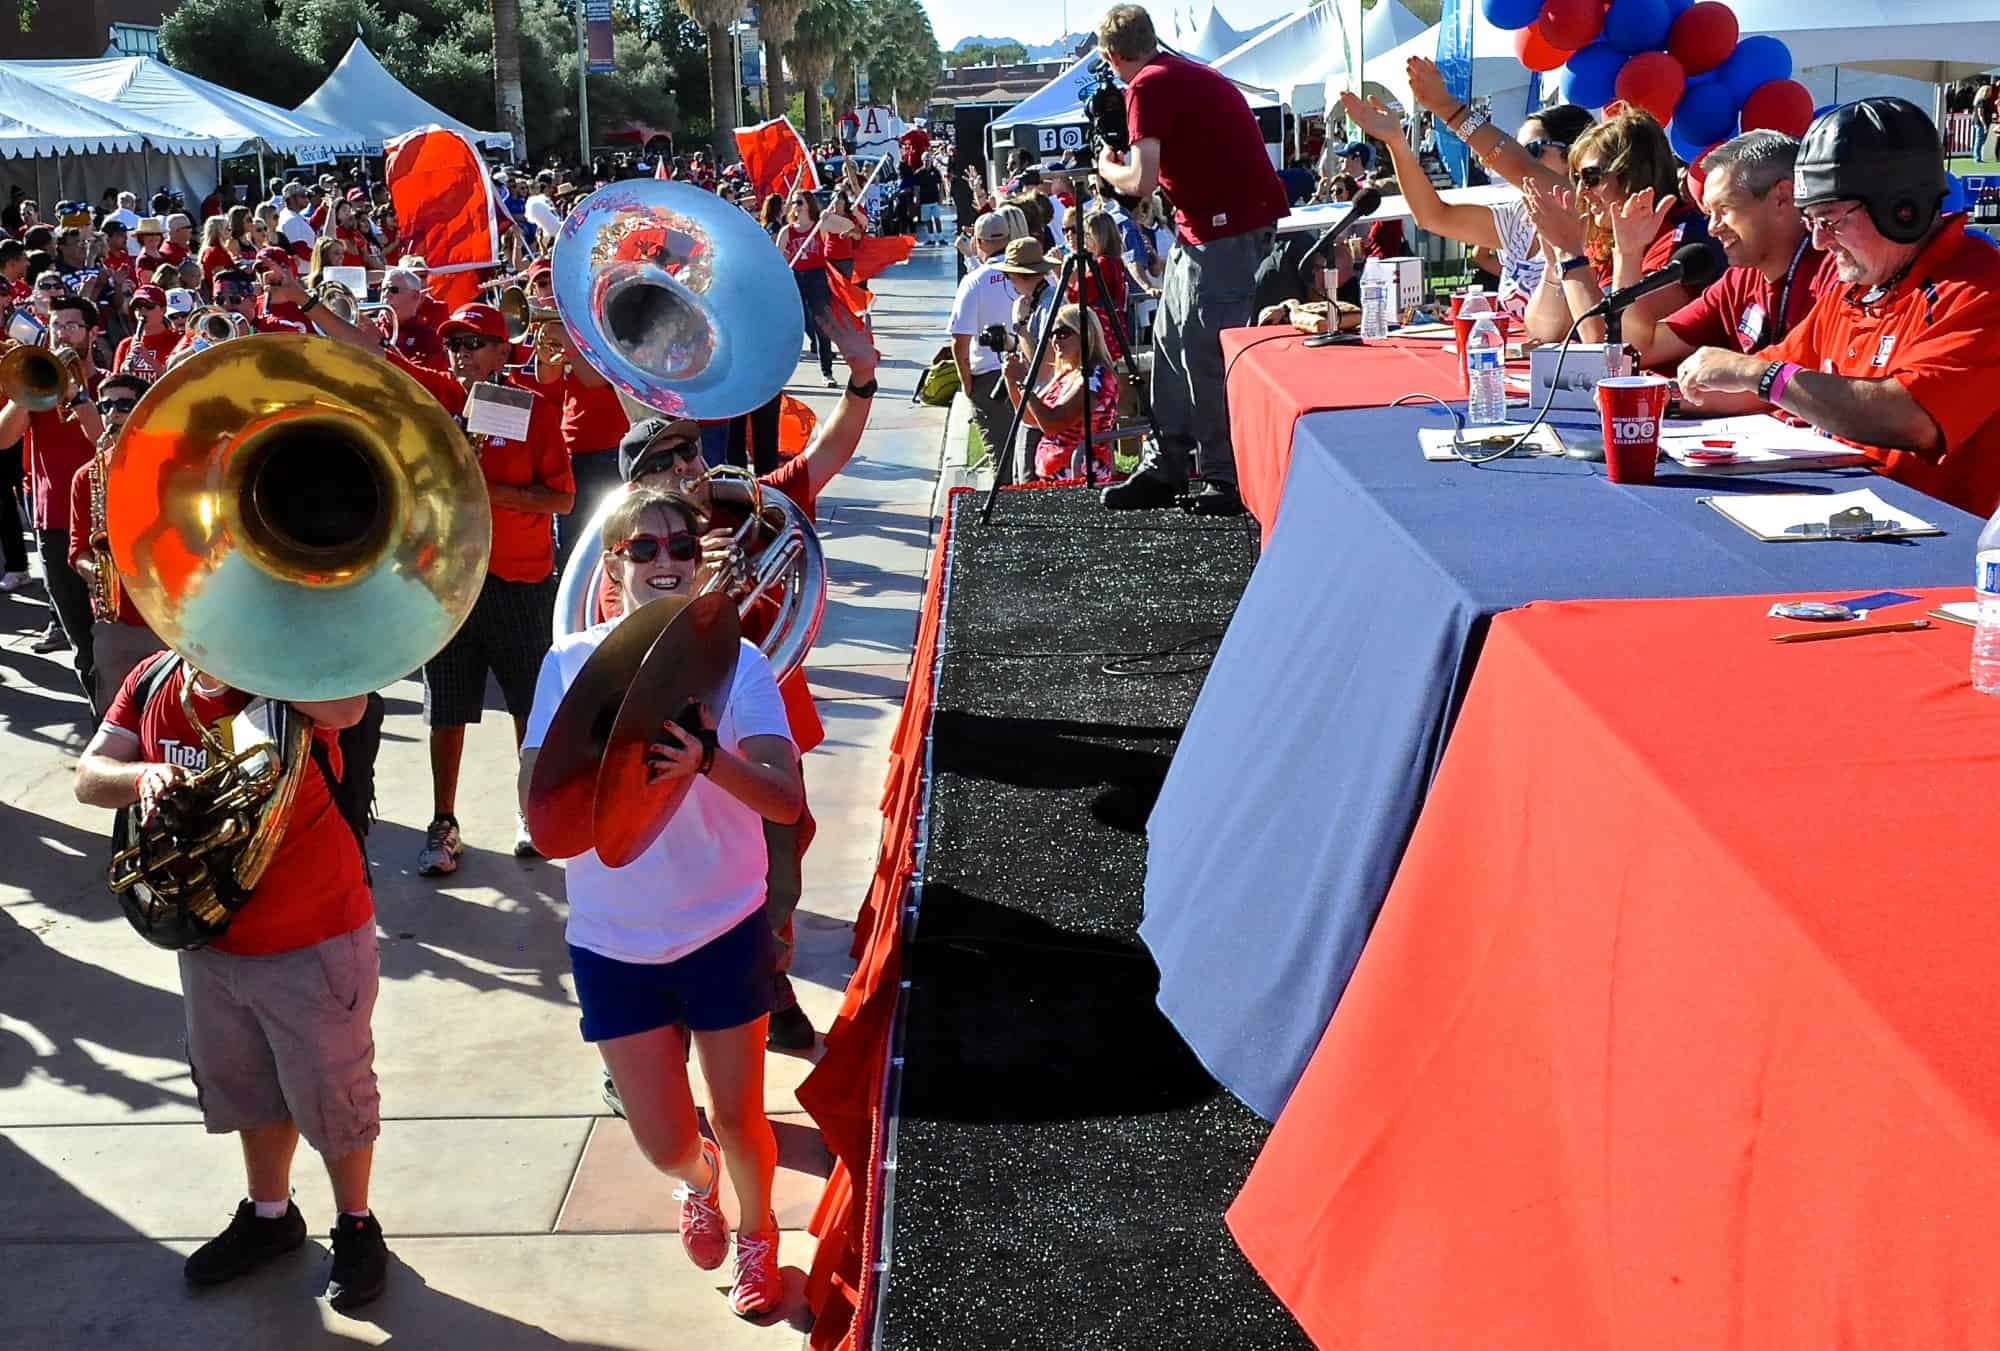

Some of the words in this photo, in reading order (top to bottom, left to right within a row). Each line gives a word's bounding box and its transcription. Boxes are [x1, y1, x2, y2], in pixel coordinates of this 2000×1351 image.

[864, 108, 882, 134] A
[1612, 422, 1655, 439] 100
[158, 738, 208, 770] TUBA
